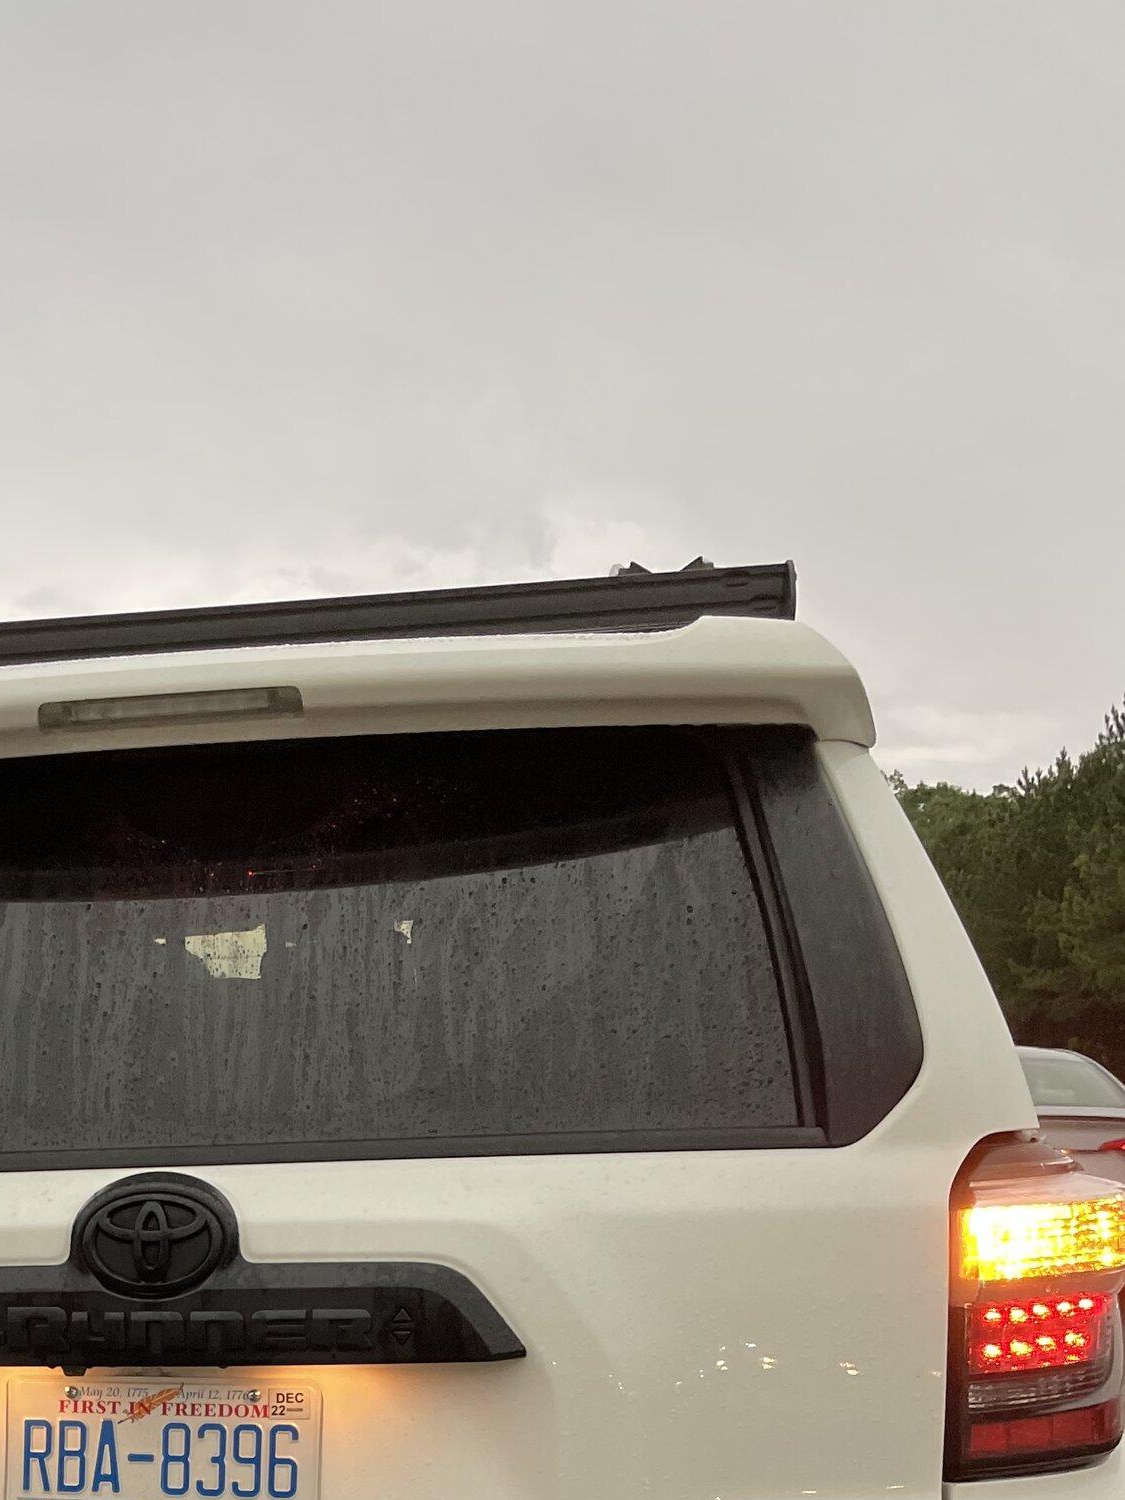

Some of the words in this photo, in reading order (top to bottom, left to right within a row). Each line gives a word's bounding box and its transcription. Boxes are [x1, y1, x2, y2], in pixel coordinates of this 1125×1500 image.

[80, 1387, 103, 1399] May
[127, 1387, 150, 1398] 1775
[177, 1388, 204, 1401] April
[276, 1392, 304, 1404] DEC
[59, 1400, 121, 1415] FIRST
[128, 1401, 151, 1415] IN
[161, 1402, 269, 1418] FREEDOM
[271, 1405, 286, 1416] 22
[22, 1419, 300, 1499] RBA-8396
